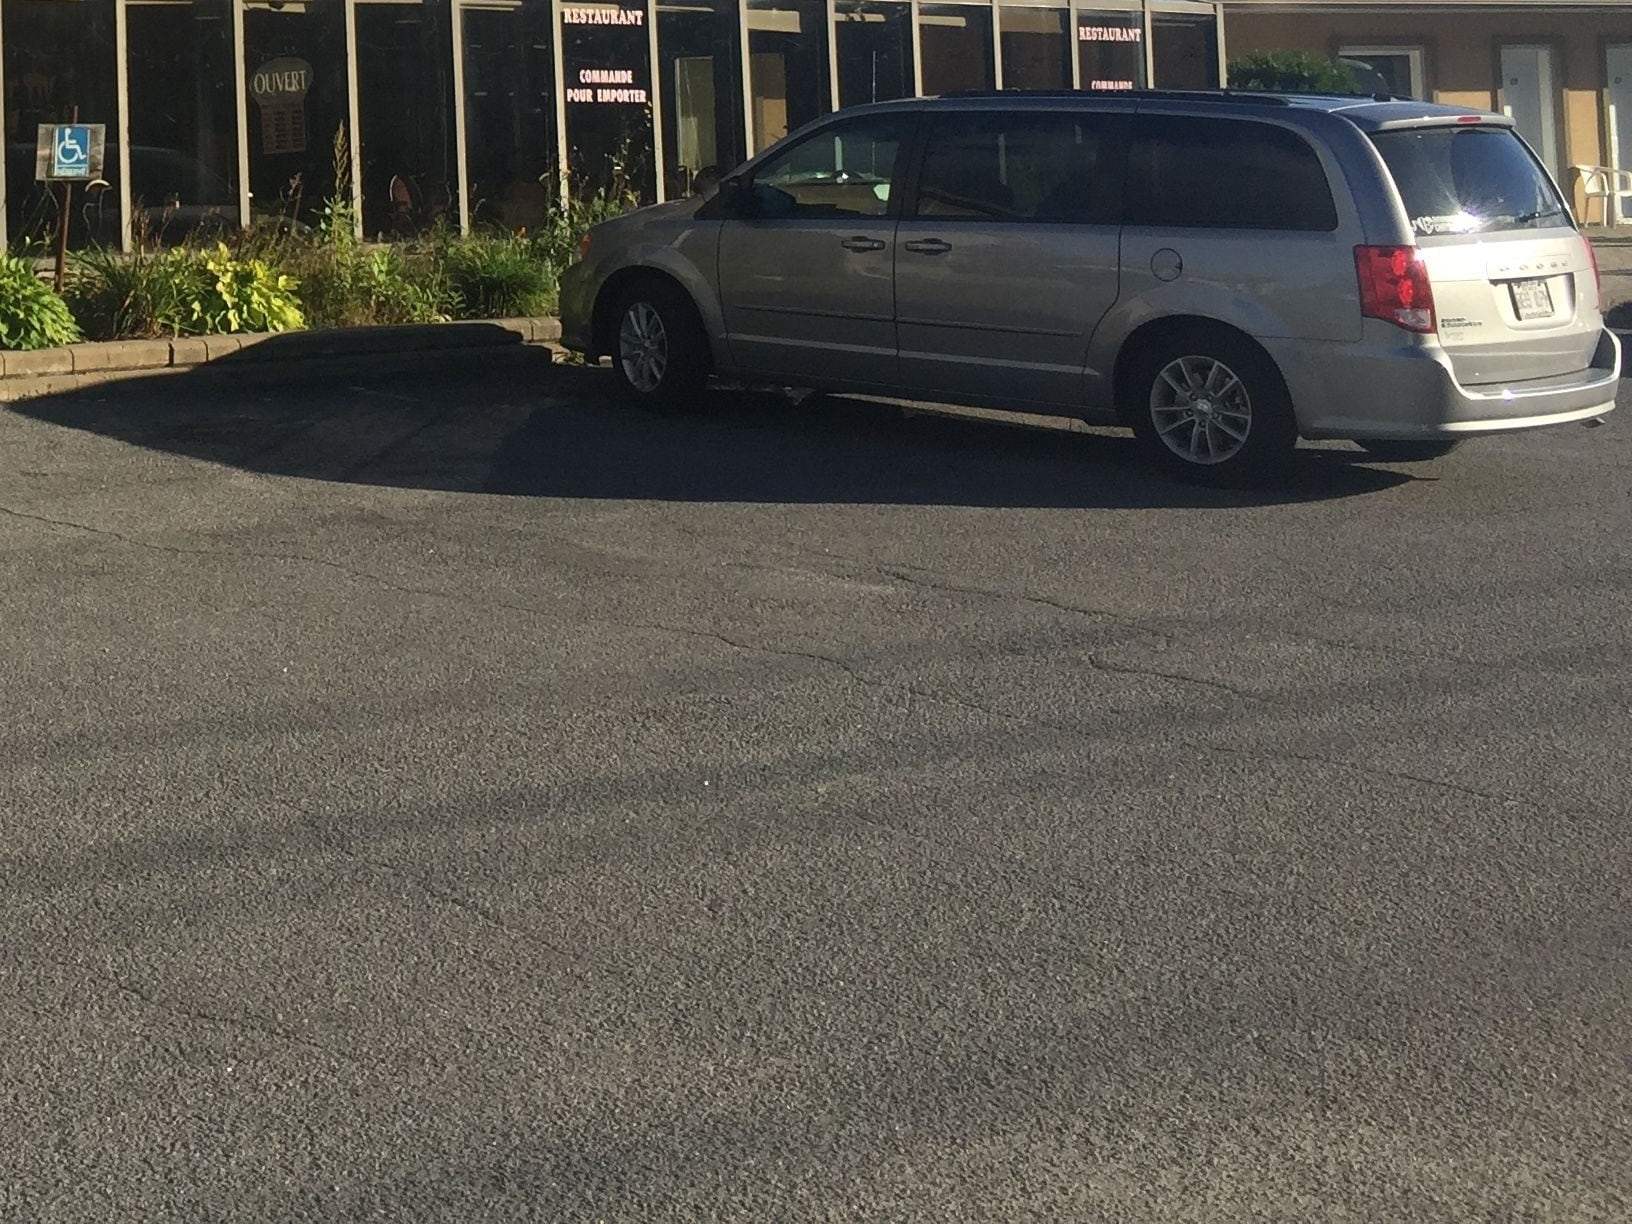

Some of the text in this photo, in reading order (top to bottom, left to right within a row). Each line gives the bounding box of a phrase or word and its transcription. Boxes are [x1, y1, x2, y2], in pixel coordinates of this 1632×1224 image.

[563, 7, 644, 26] RESTAURANT
[1078, 26, 1142, 42] RESTAURANT
[253, 70, 307, 94] OUVERT
[579, 69, 633, 84] COMMANDE
[1091, 80, 1133, 90] COMMANDE
[566, 88, 647, 103] POUR EMPORTER
